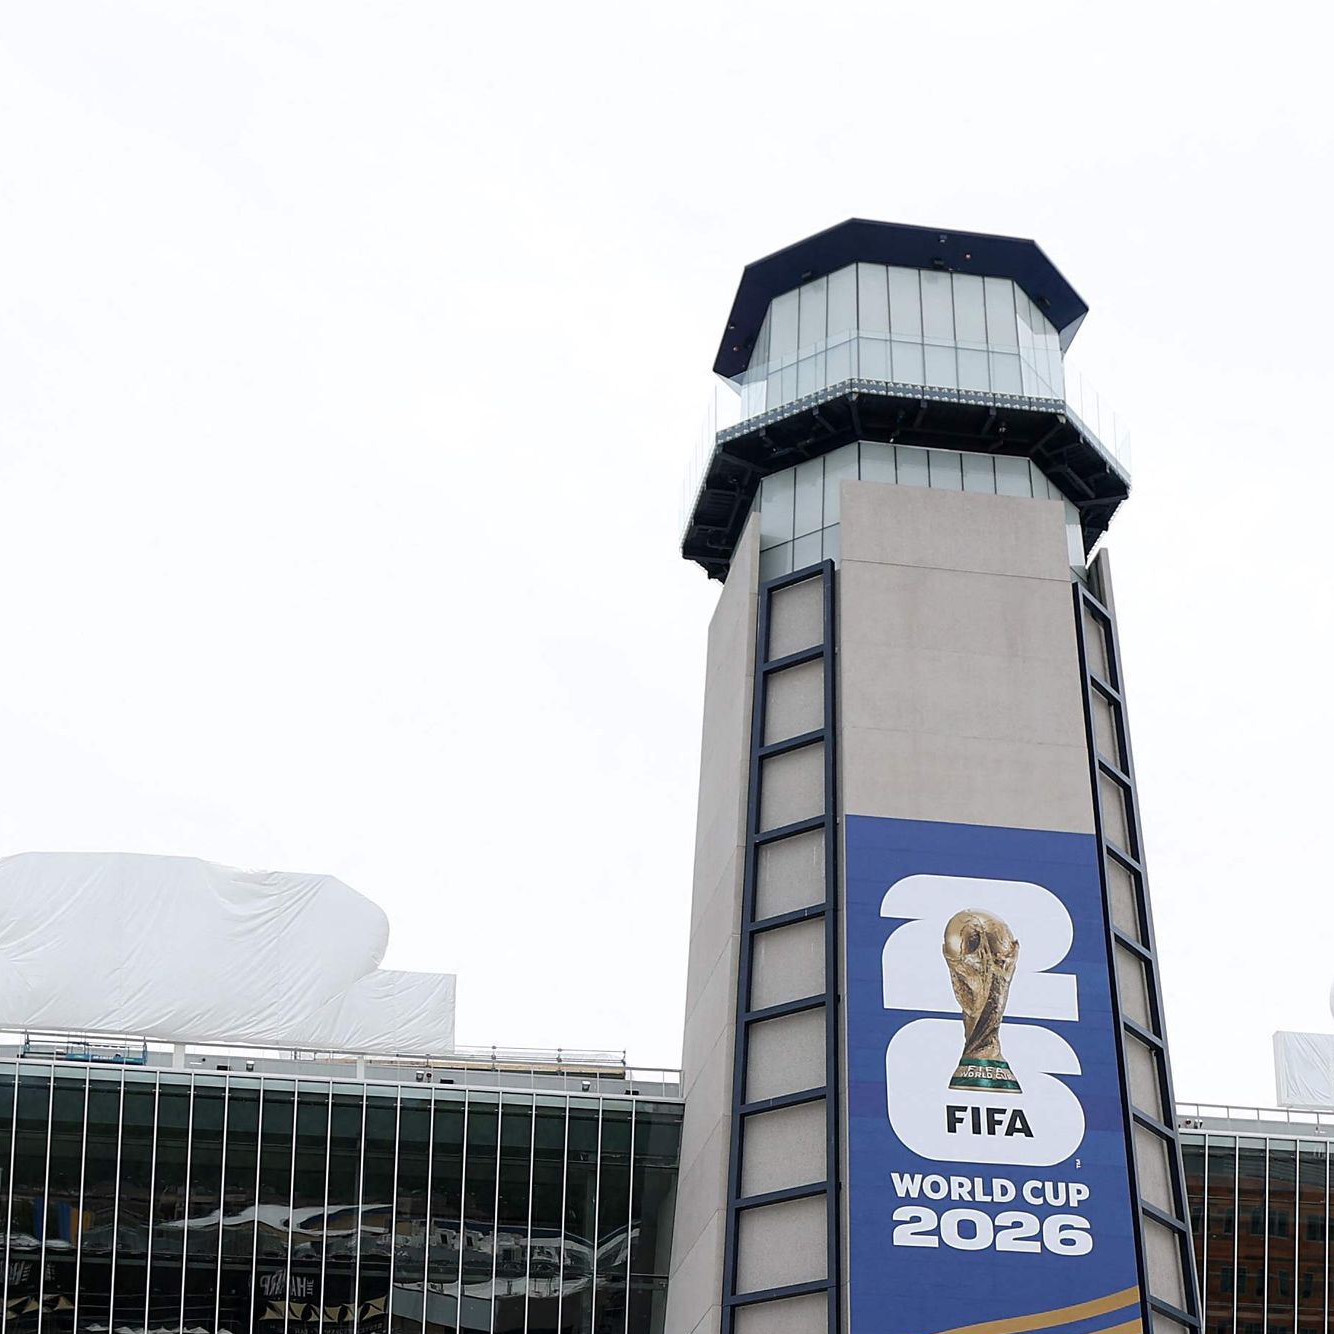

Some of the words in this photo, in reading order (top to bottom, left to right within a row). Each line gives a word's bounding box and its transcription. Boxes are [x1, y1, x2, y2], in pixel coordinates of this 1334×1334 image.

[946, 1105, 1034, 1138] FIFA
[891, 1172, 1016, 1202] WORLD
[1021, 1179, 1090, 1207] CUP
[892, 1205, 1093, 1256] 2026
